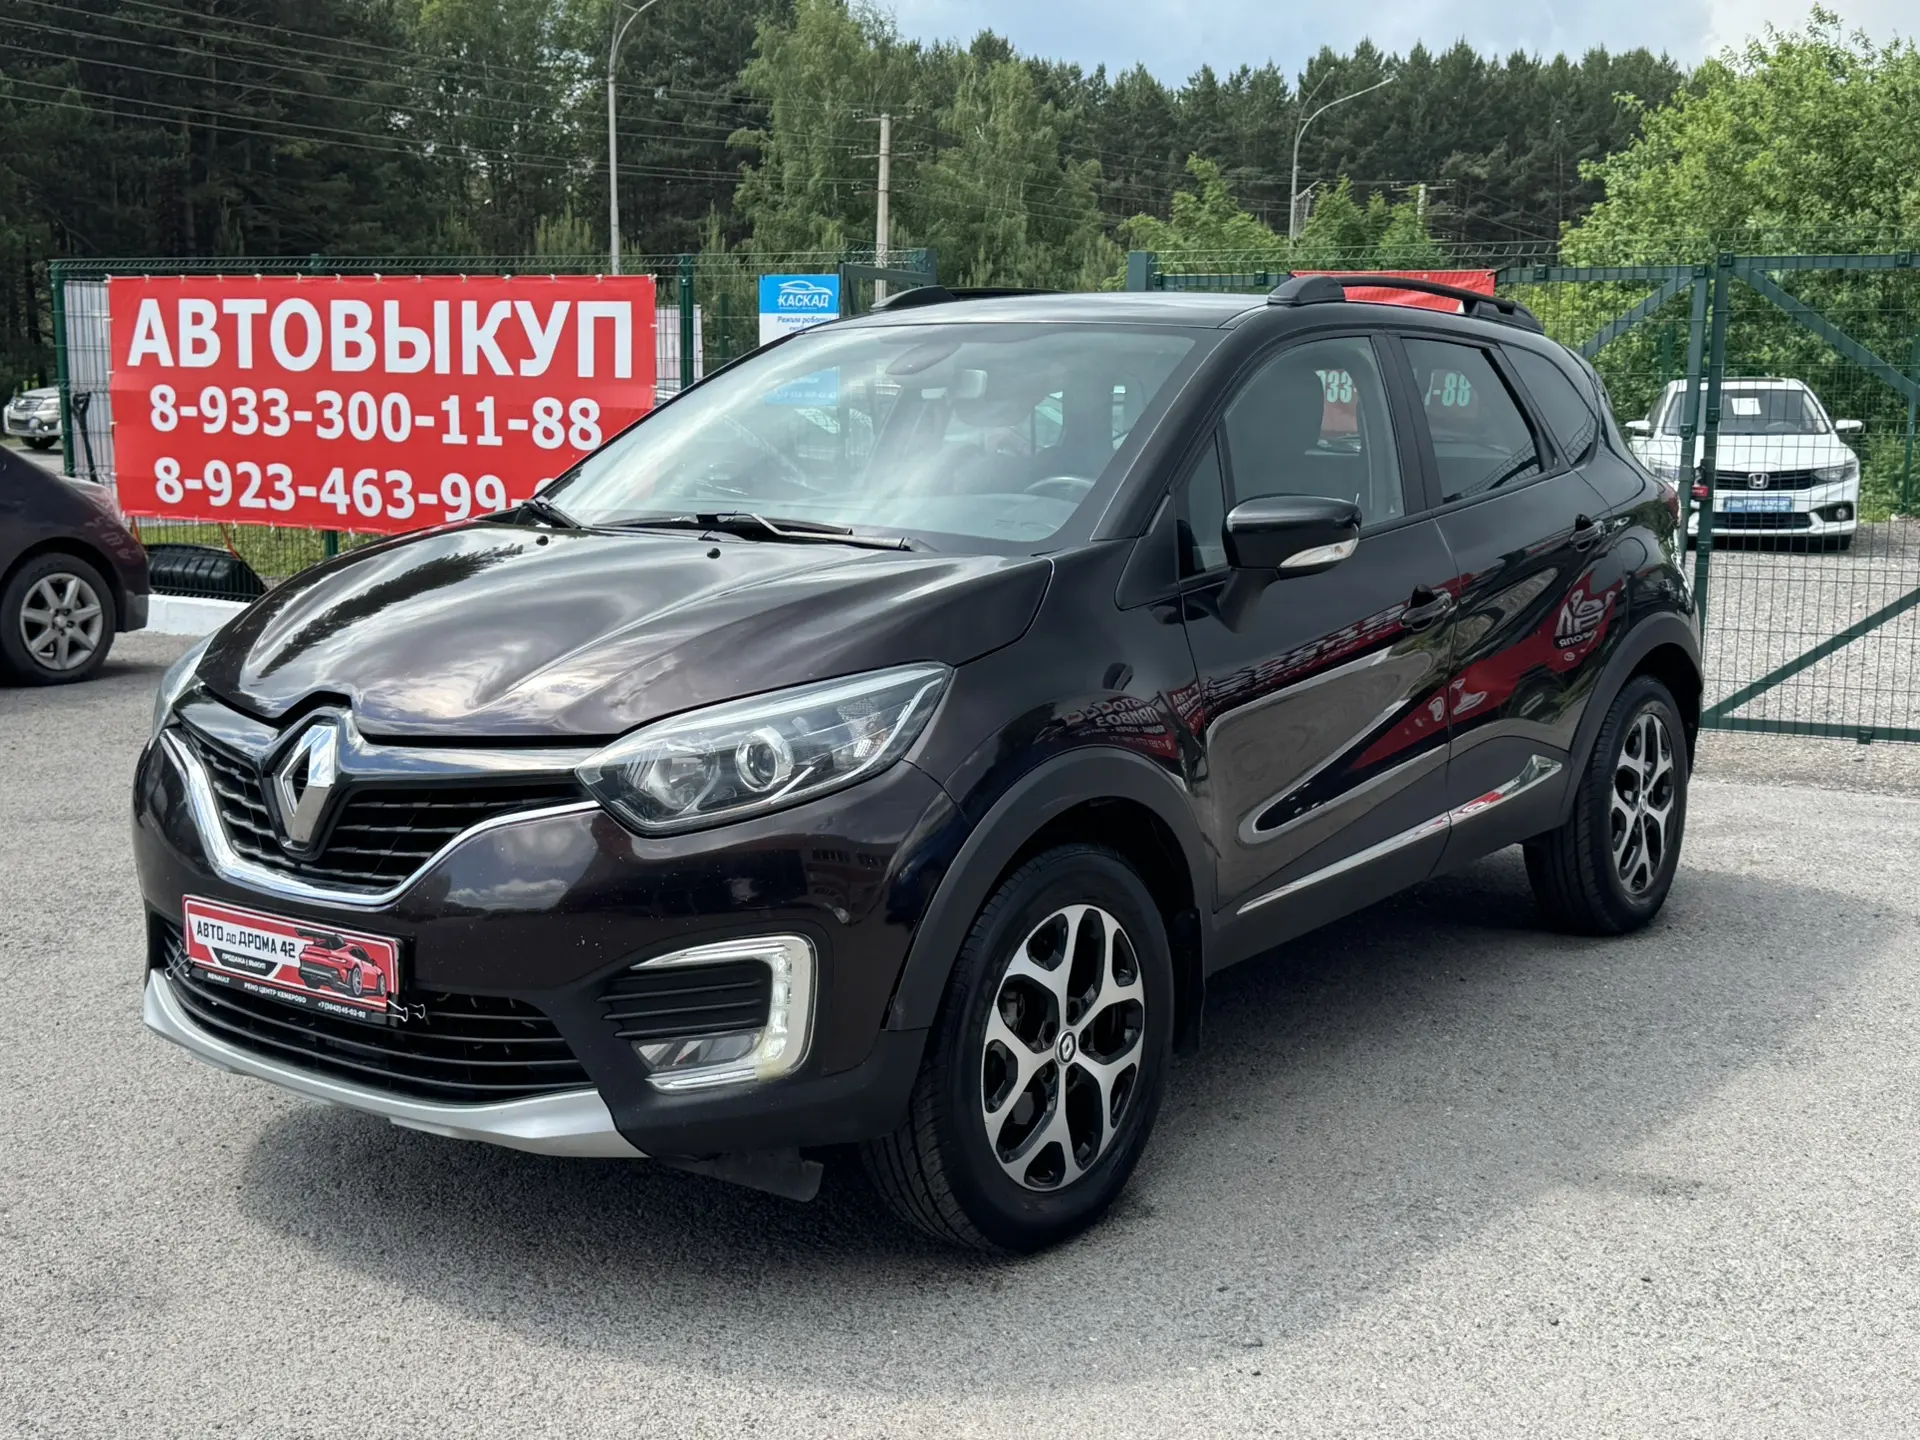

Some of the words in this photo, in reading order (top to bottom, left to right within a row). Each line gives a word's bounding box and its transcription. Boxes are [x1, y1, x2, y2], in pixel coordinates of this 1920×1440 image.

[777, 294, 829, 308] КАСКАД
[127, 298, 632, 378] АВТОВЫКУП
[150, 384, 602, 450] 8-933-300-11-88
[154, 457, 555, 522] 8-923-463-99-
[197, 920, 224, 942] АВТО
[238, 931, 277, 954] ДРОМА
[280, 940, 296, 958] 42
[207, 972, 230, 984] RENAULT
